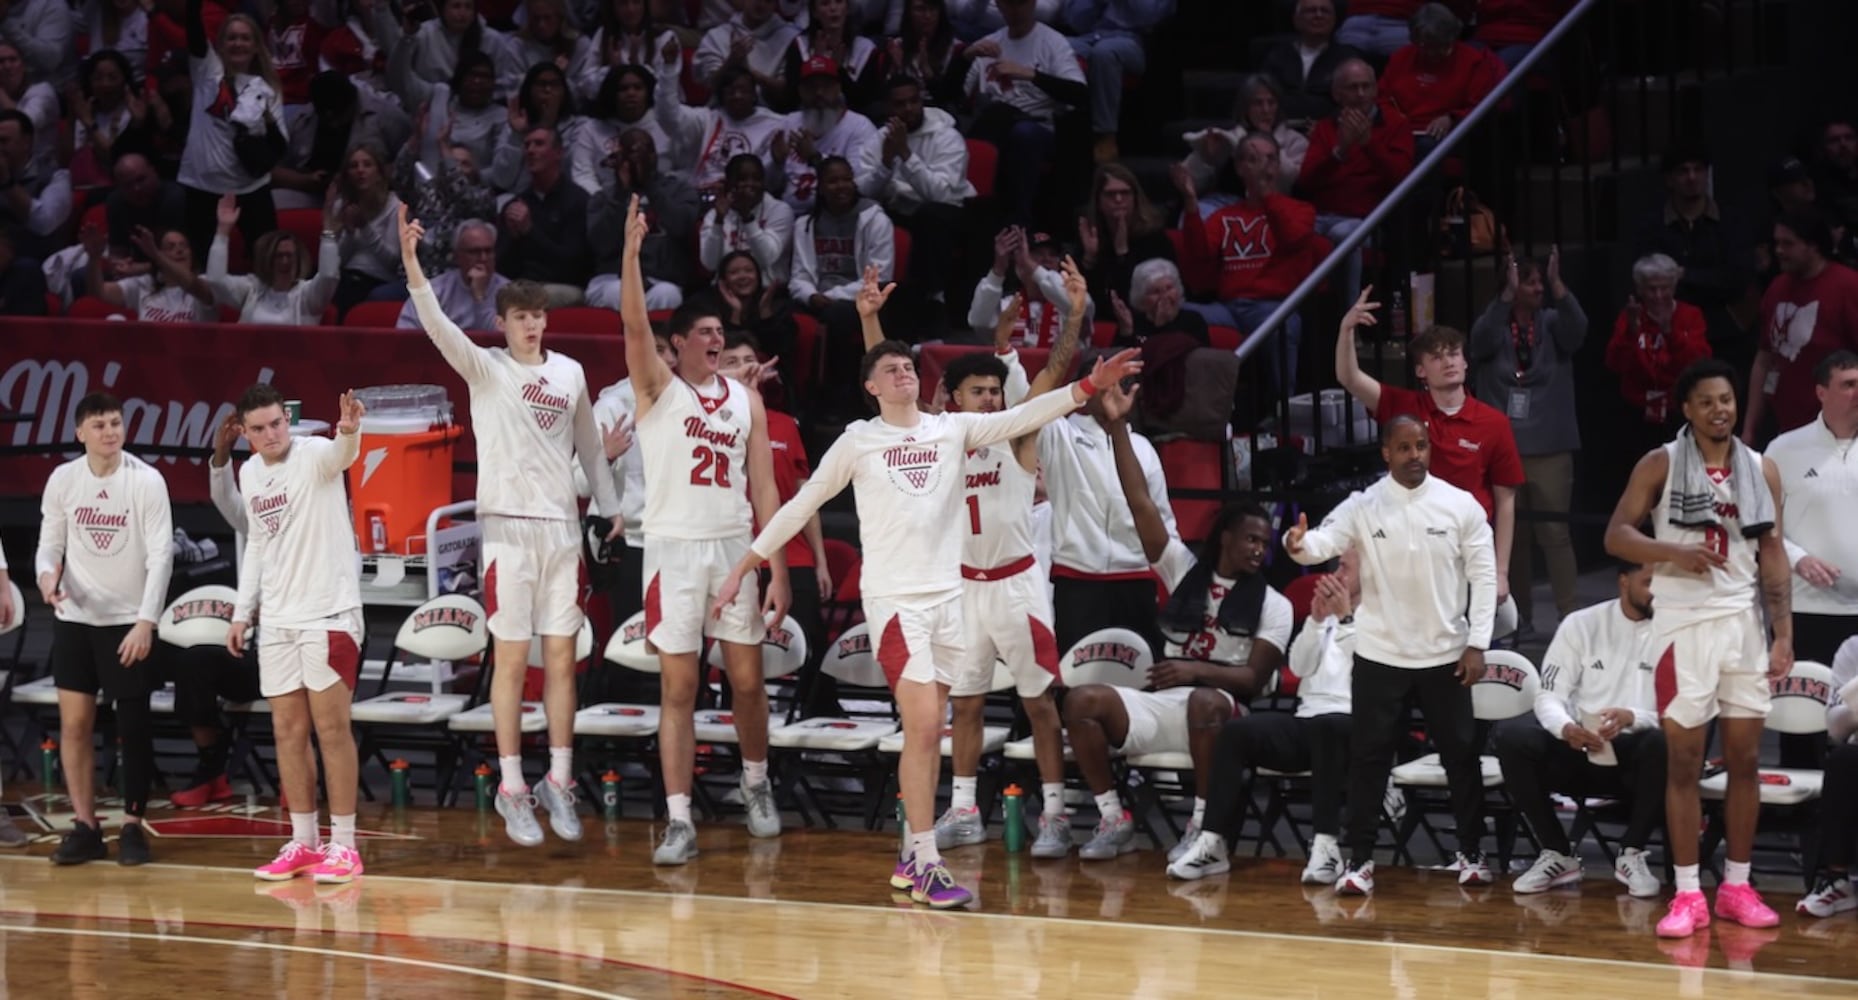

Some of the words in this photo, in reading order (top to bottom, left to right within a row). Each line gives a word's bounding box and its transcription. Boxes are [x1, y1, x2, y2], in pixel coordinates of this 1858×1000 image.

[1222, 215, 1272, 262] M
[522, 383, 569, 411] Miami
[683, 416, 740, 448] Miami
[883, 444, 939, 468] Miami
[965, 462, 1002, 489] ami
[250, 487, 288, 514] Miami
[74, 507, 130, 527] Miami
[965, 494, 982, 535] 1
[172, 599, 234, 624] MIAM
[414, 607, 478, 632] MIAMI
[1073, 643, 1139, 668] MIAMI
[1484, 663, 1527, 690] AMI
